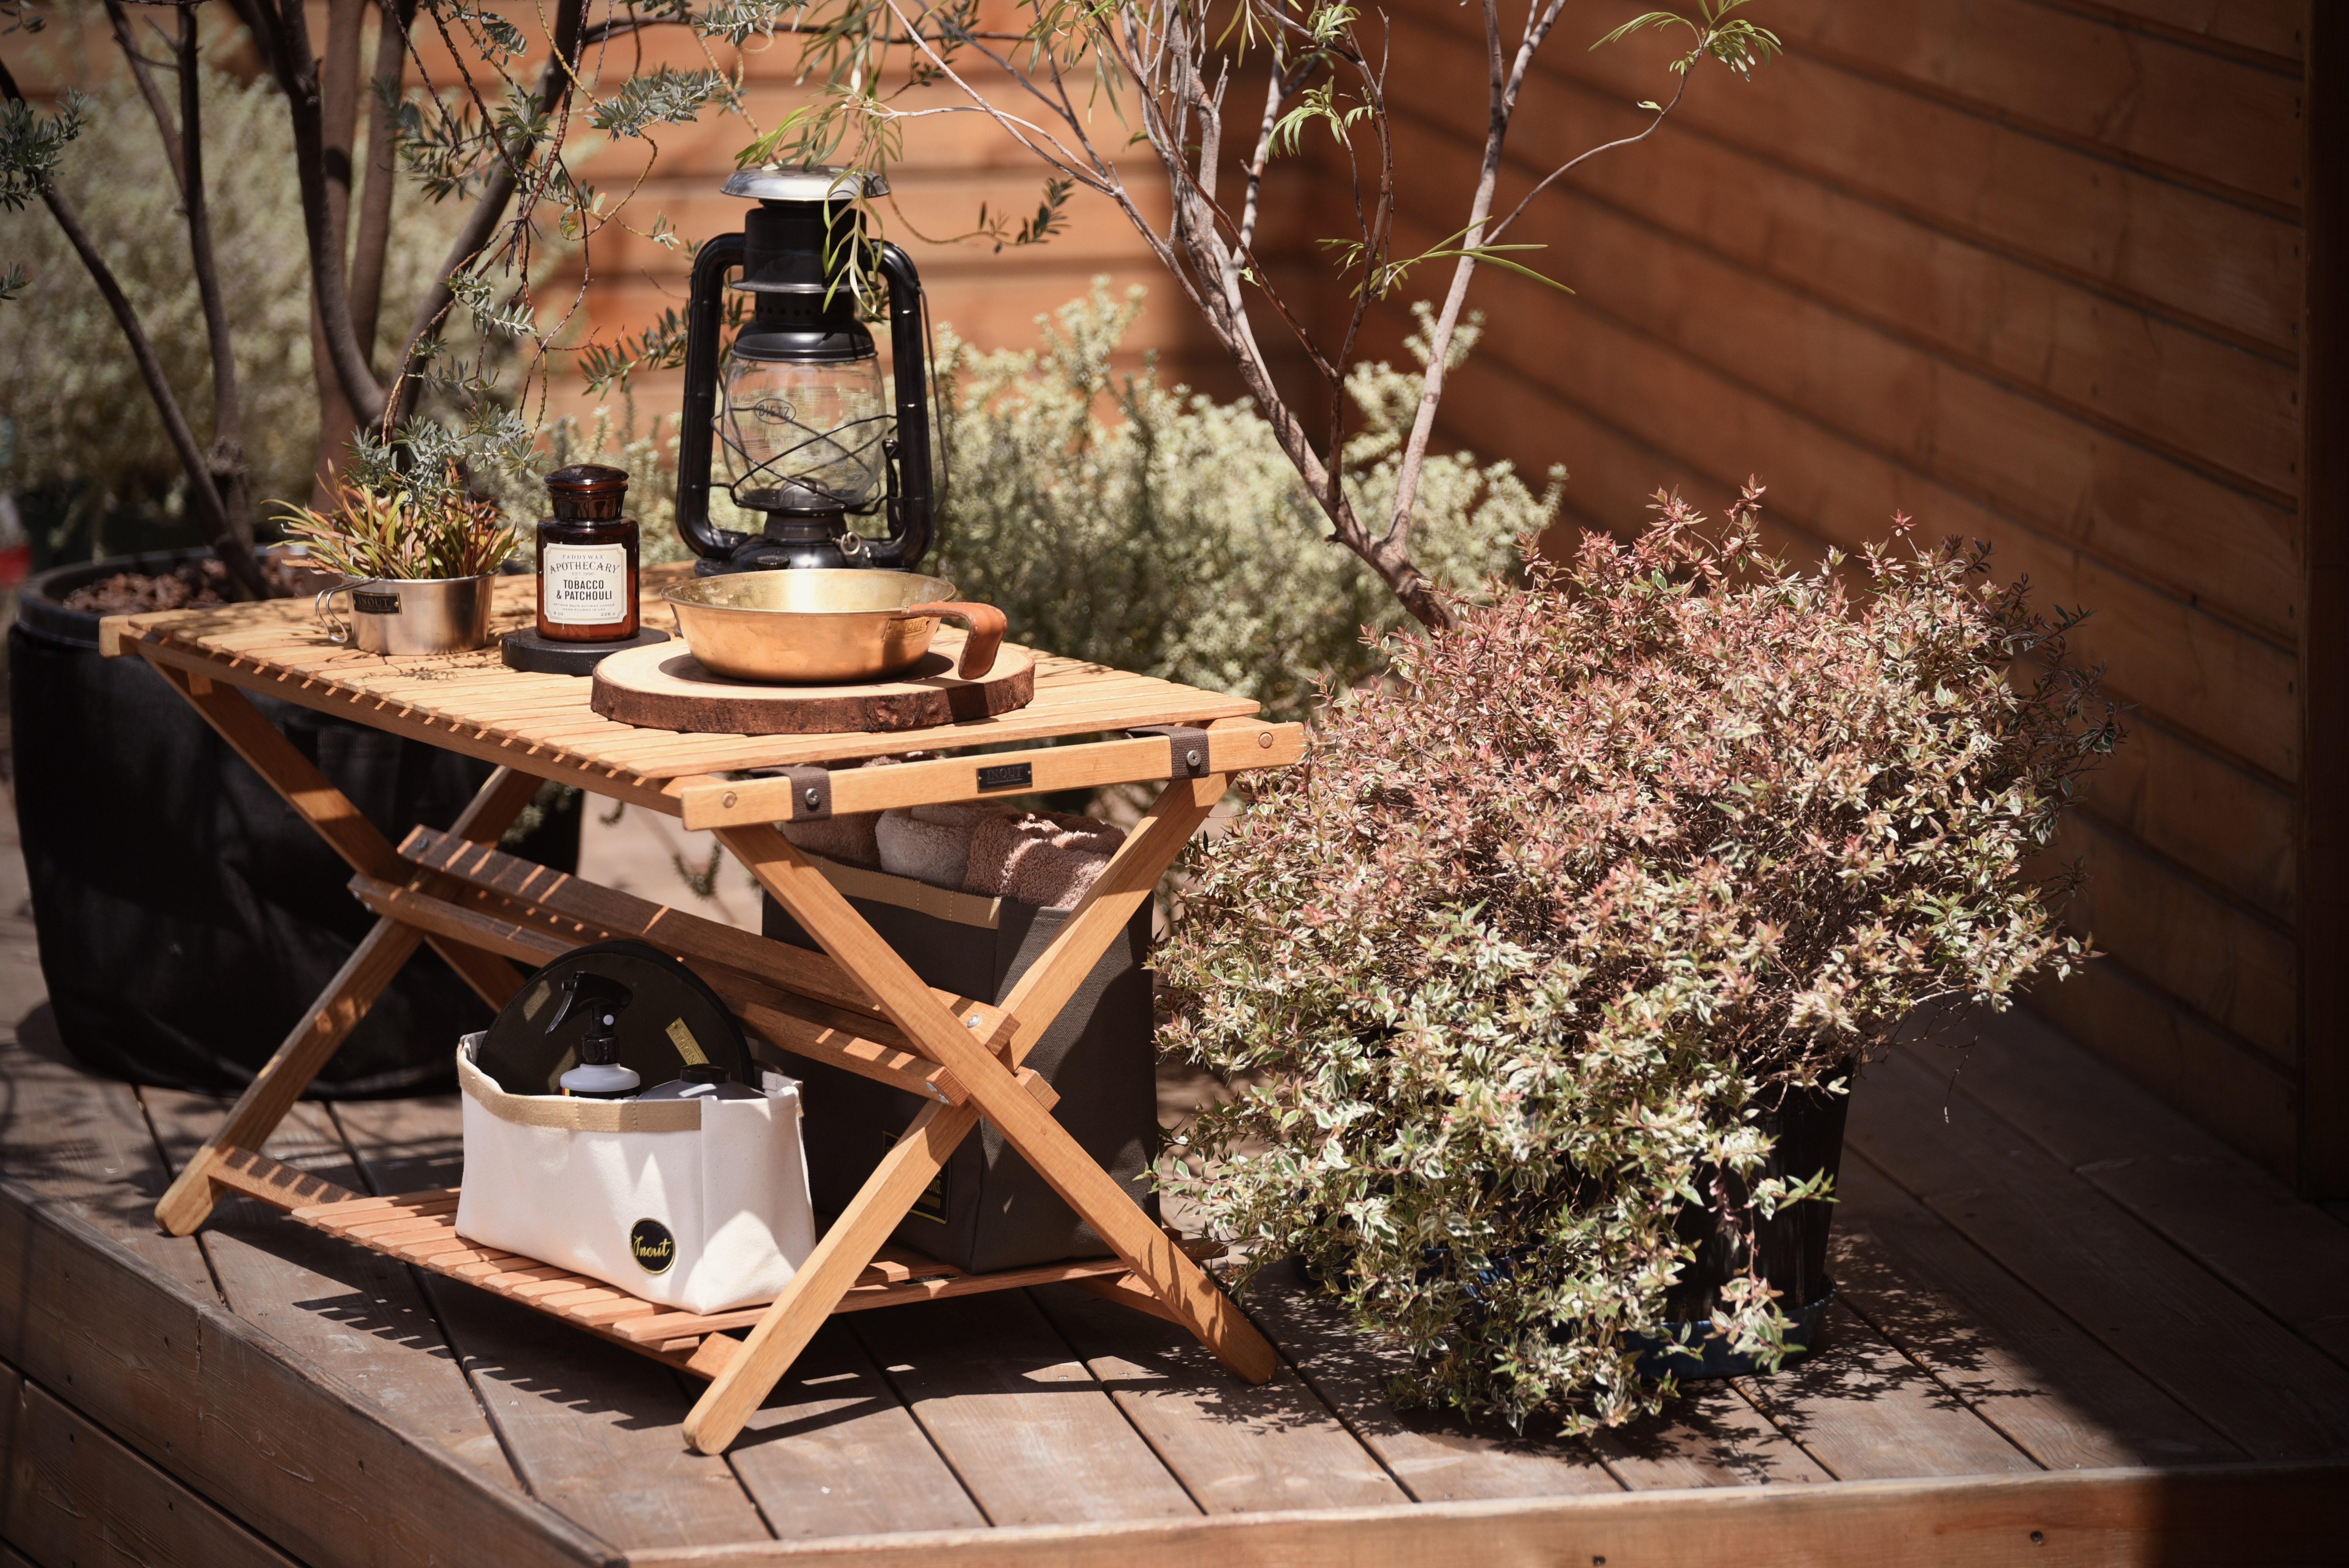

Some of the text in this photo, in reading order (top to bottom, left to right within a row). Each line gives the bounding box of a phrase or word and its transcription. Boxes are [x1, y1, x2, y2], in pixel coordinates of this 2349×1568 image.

[550, 561, 620, 574] APOTHECARY
[563, 580, 604, 589] TOBACCO
[556, 590, 612, 600] & PATCHOULI
[359, 596, 389, 606] INOUT
[987, 766, 1022, 779] INOUT
